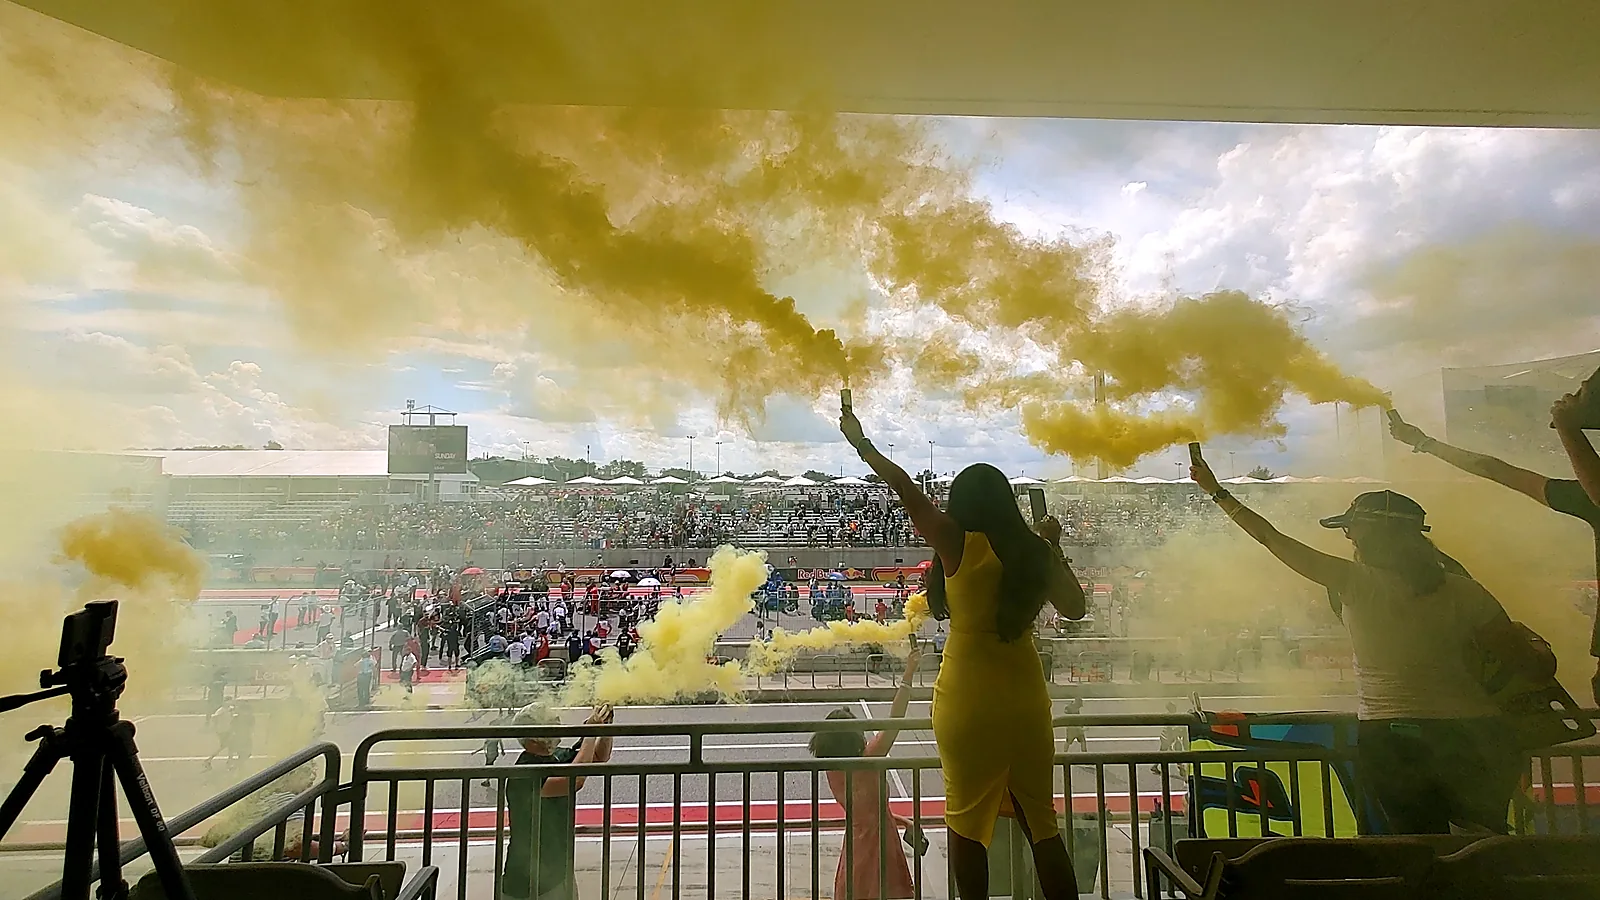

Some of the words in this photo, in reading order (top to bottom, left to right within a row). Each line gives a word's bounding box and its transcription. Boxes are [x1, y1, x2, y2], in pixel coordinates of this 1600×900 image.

[434, 452, 456, 460] SUNDAY
[798, 568, 816, 579] Red
[136, 772, 154, 806] Velbon
[150, 808, 161, 819] DF
[156, 821, 165, 832] 60
